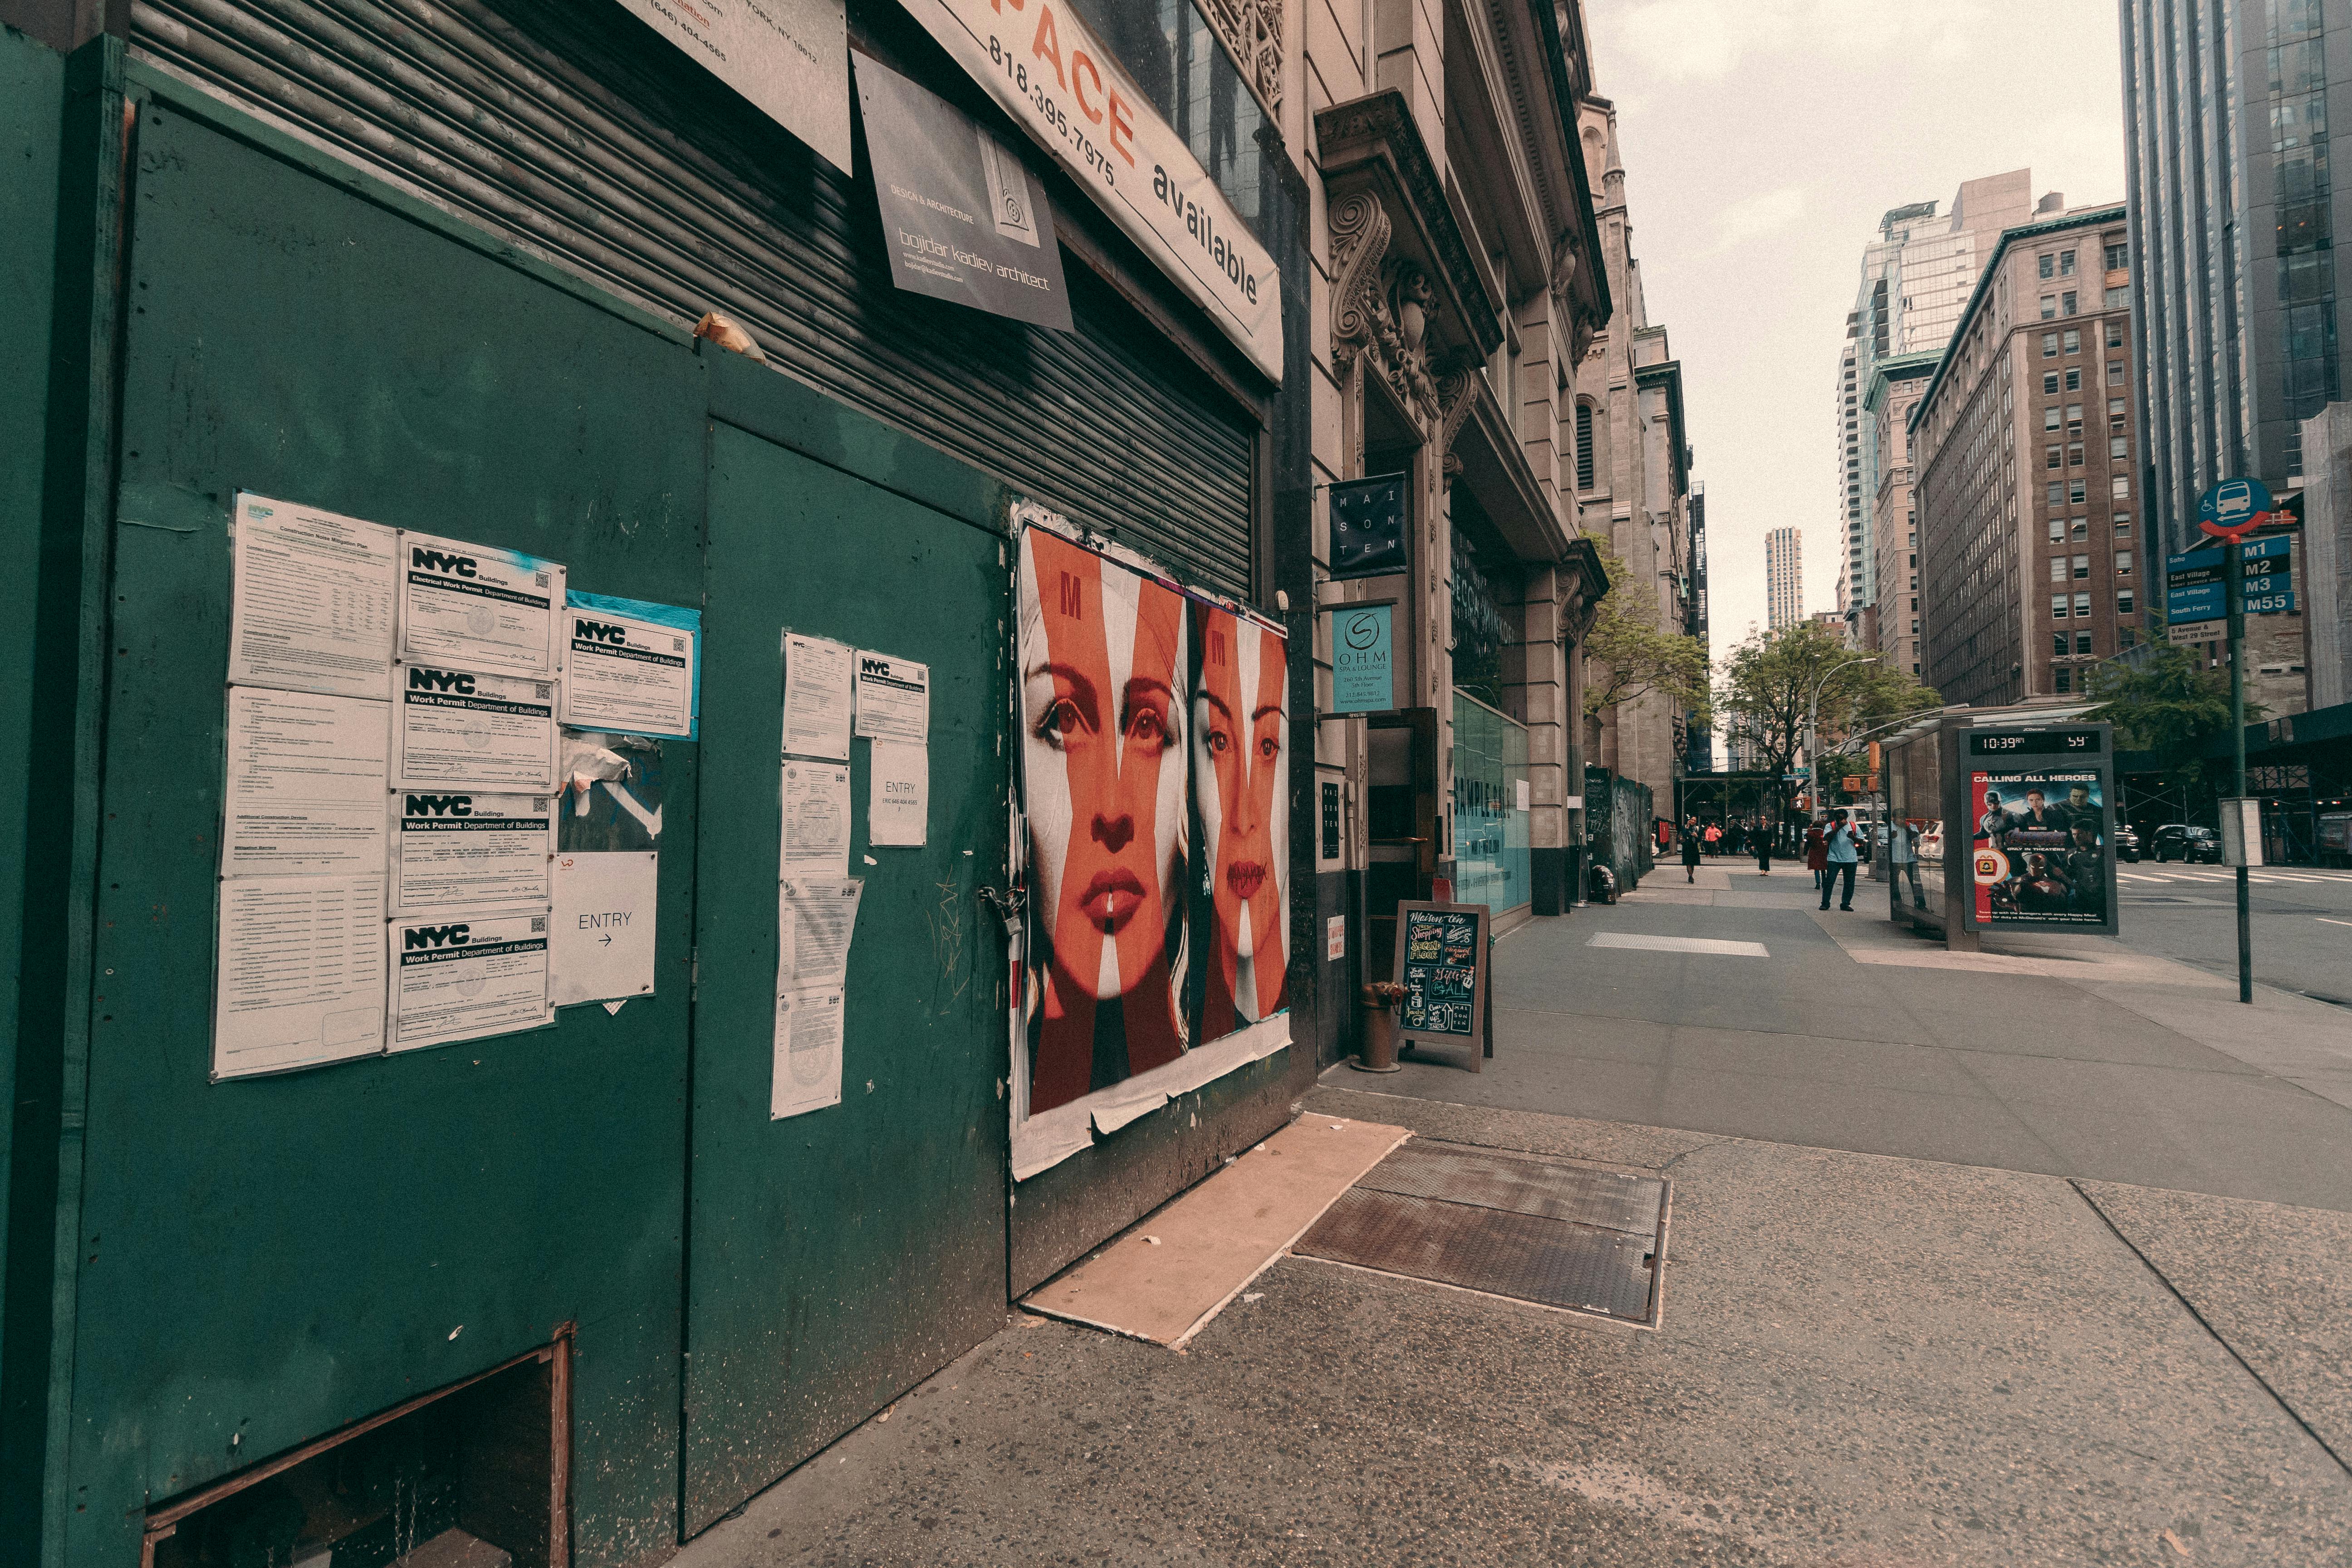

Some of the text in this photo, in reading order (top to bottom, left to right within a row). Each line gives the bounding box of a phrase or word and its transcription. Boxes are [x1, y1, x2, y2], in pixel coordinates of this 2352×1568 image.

[681, 23, 726, 62] 404-4565
[779, 26, 790, 40] NY
[794, 40, 817, 64] 10012
[991, 0, 1135, 170] ACE
[990, 35, 1114, 186] 818.395.7975
[891, 184, 974, 225] DESIGN & ARCHITECTURE
[1153, 164, 1257, 305] available
[899, 227, 1050, 291] bojidar kadiev architect
[903, 252, 955, 272] www.kadievstudio.com
[905, 260, 963, 283] bojidar@kadievstudio.com
[280, 526, 314, 538] Construction
[331, 537, 356, 547] Mitigation
[2244, 542, 2266, 557] M1
[412, 547, 477, 578] NYC
[2245, 560, 2270, 576] M2
[479, 574, 508, 587] Buildings
[2245, 578, 2270, 593] M3
[412, 575, 441, 586] Electrical
[443, 580, 460, 589] Work
[461, 584, 483, 593] Permit
[485, 589, 517, 601] Department
[524, 597, 548, 607] Buildings
[1060, 570, 1081, 621] M
[2247, 595, 2286, 611] M55
[575, 619, 626, 646] NYC
[575, 643, 593, 652] Work
[595, 646, 617, 656] Permit
[619, 651, 652, 662] Department
[660, 656, 683, 666] Buildings
[627, 641, 651, 650] Buildings
[1212, 630, 1225, 667] M
[862, 658, 890, 676] NYC
[1339, 651, 1386, 665] OHM
[409, 667, 475, 695] NYC
[410, 695, 435, 704] Work
[437, 697, 466, 707] Permit
[468, 700, 508, 712] Department
[519, 706, 548, 716] Buildings
[477, 691, 507, 700] Buildings
[1984, 737, 2015, 749] 10:39
[886, 781, 916, 794] ENTRY
[1454, 776, 1510, 818] SAMPLE SALE
[406, 794, 472, 816] NYC
[464, 822, 505, 831] Department
[516, 822, 545, 831] Buildings
[579, 911, 632, 929] ENTRY
[1410, 911, 1466, 924] Maison ten
[405, 924, 470, 950] NYC
[1411, 926, 1443, 941] Shopping
[431, 952, 460, 961] Permit
[461, 946, 504, 958] Department
[514, 942, 544, 951] Buildings
[1410, 951, 1438, 960] FLOOR
[1411, 940, 1441, 951] SECOND
[1432, 968, 1460, 985] Gifts
[1445, 982, 1470, 995] ALL
